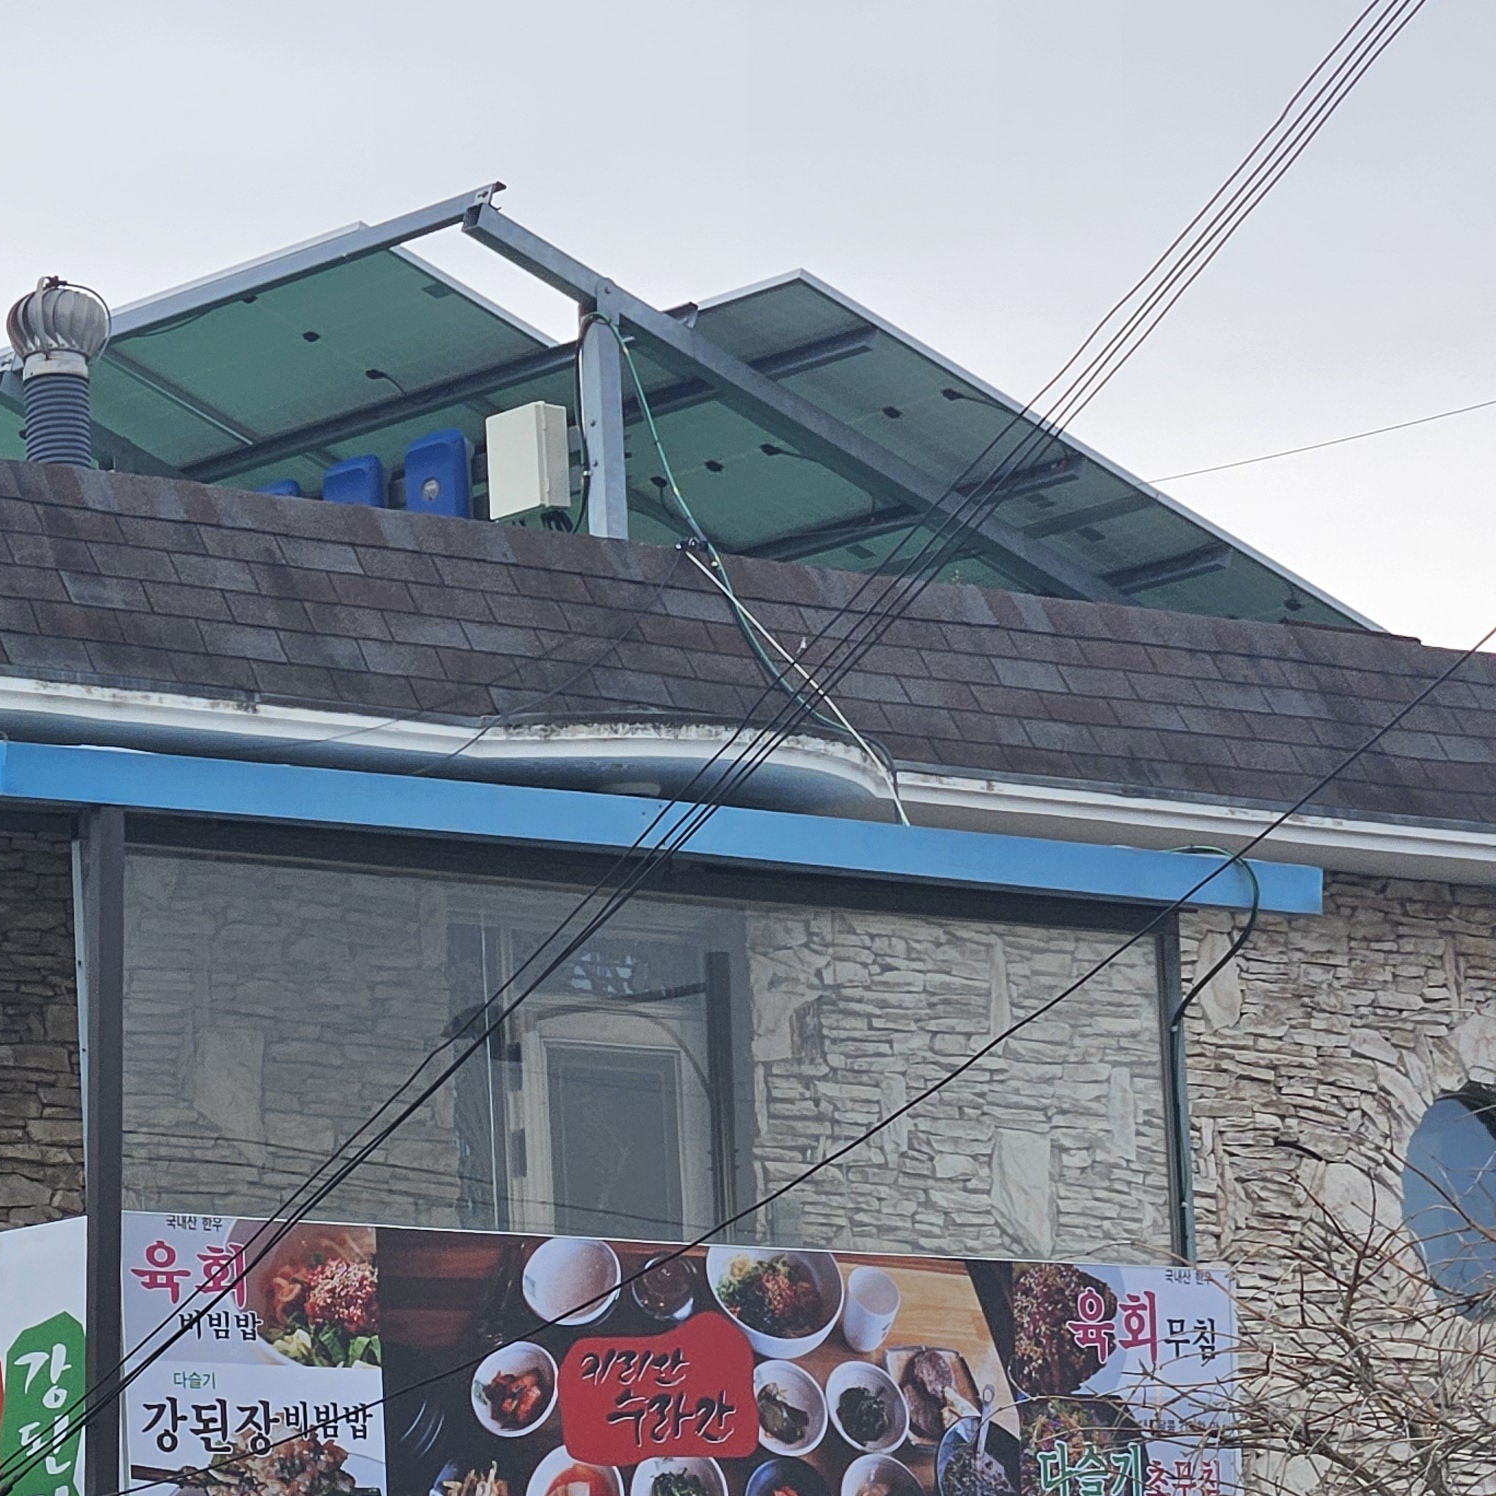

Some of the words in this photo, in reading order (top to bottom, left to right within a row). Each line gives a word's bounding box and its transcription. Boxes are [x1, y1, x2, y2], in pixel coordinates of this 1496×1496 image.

[165, 1216, 197, 1230] 국내산
[202, 1217, 223, 1232] 한우
[131, 1240, 246, 1308] 육회
[178, 1310, 263, 1341] 비빔밥
[173, 1371, 216, 1389] 다슬기
[581, 1348, 691, 1387] 지리산
[607, 1389, 737, 1448] 수라간
